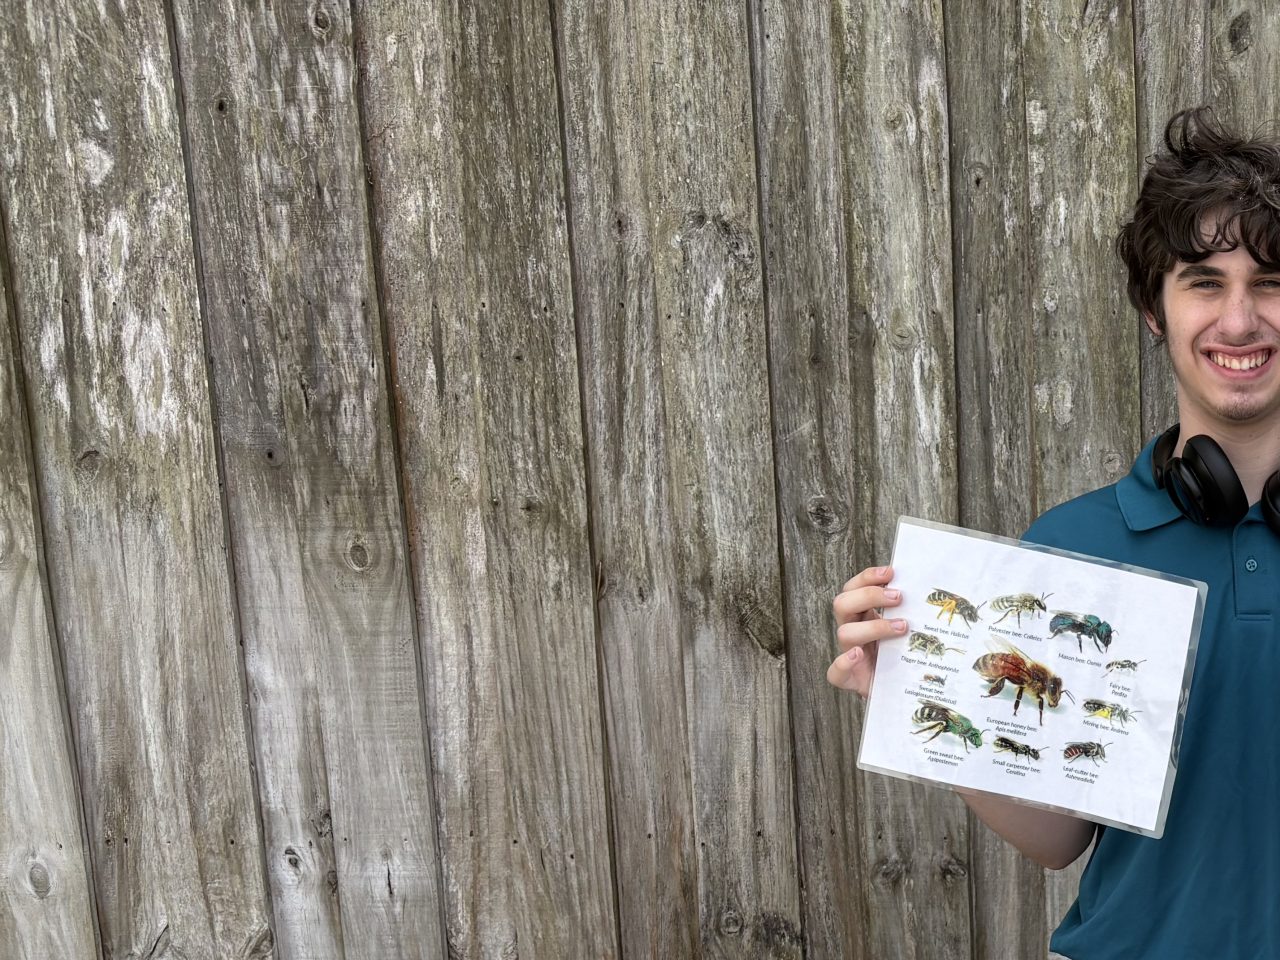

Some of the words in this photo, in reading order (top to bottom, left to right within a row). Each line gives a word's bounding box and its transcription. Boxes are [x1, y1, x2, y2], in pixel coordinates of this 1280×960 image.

[989, 626, 1011, 635] Polyester
[987, 717, 1010, 728] European
[1006, 763, 1029, 772] carpenter
